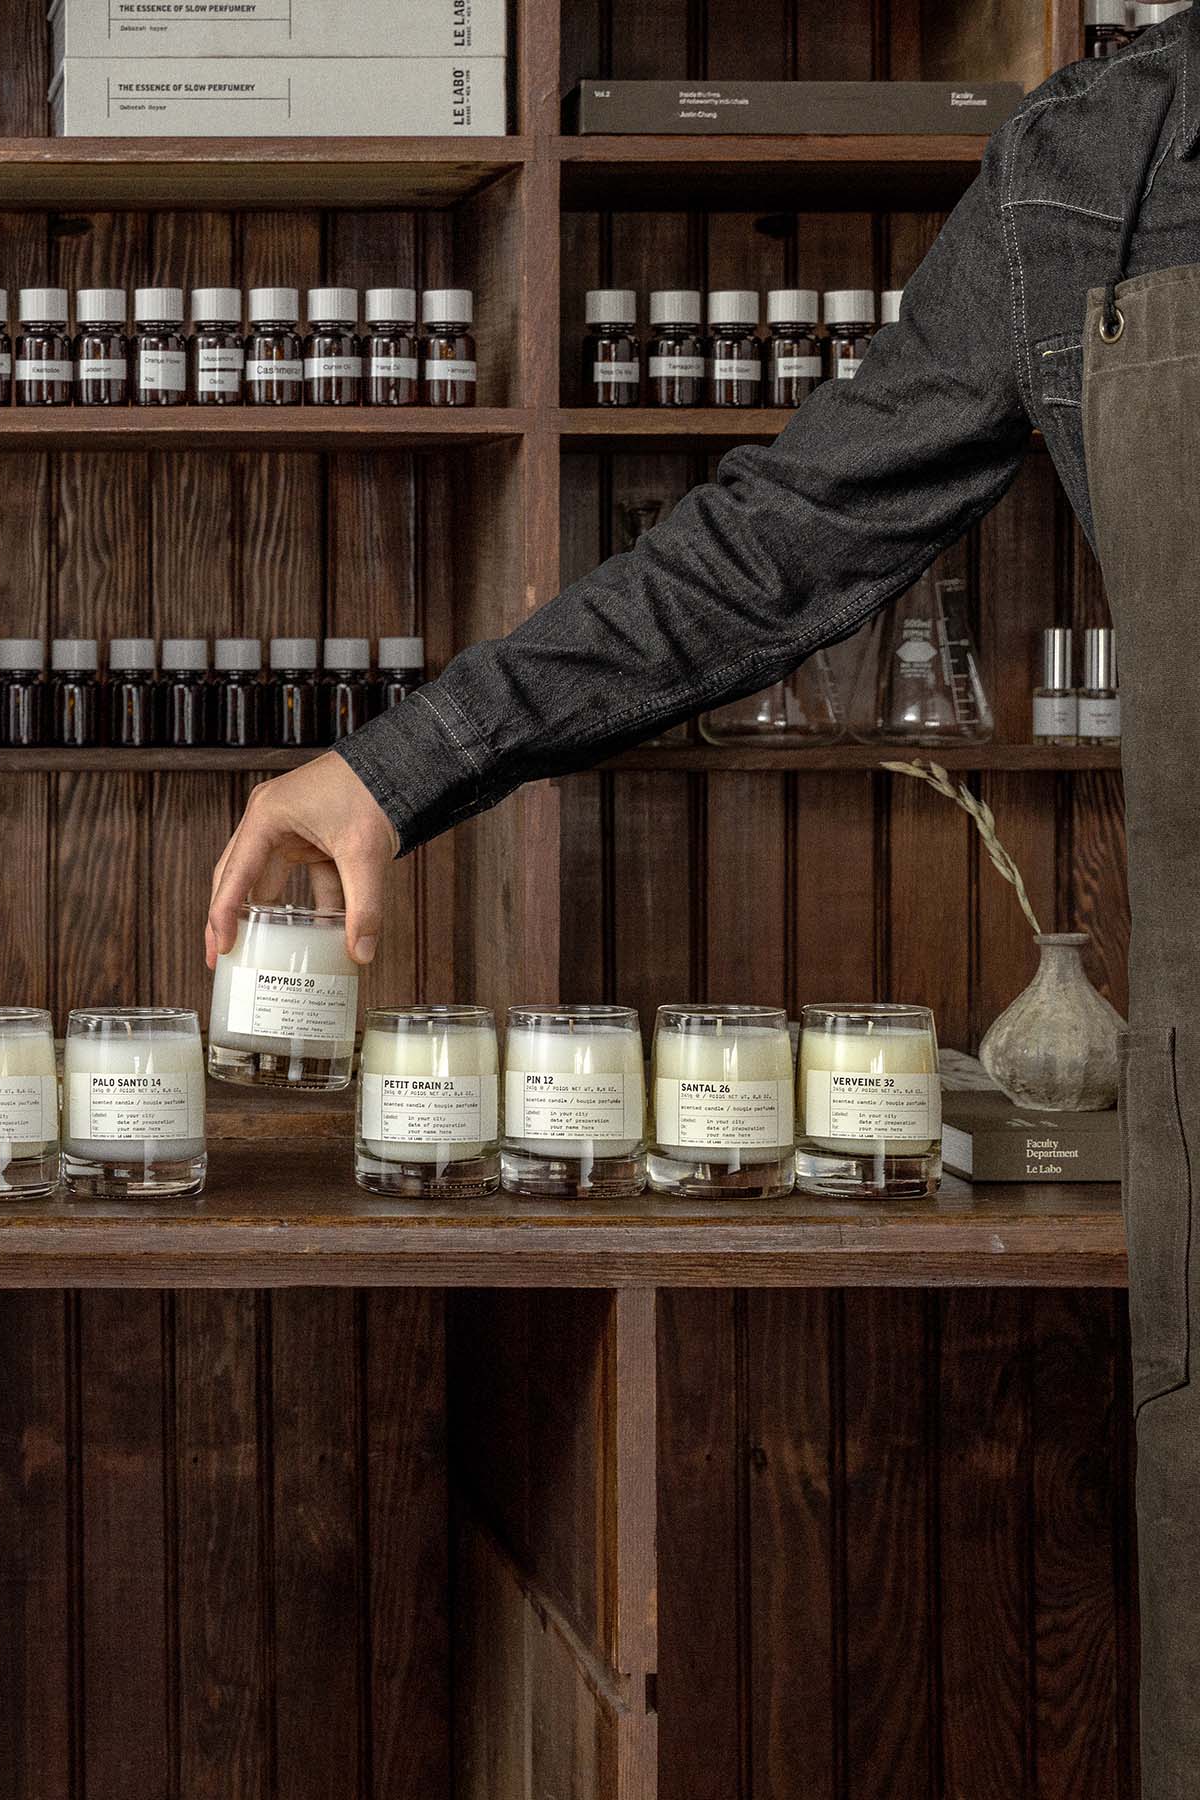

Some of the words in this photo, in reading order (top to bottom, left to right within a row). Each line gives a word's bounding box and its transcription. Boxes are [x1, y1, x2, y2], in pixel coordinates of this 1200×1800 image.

[454, 29, 465, 46] LE
[453, 70, 465, 105] LABO
[453, 108, 465, 125] LE
[699, 111, 717, 119] Chung
[258, 974, 302, 987] PAPYRUS
[304, 979, 315, 988] 20
[93, 1078, 115, 1087] PALO
[117, 1078, 148, 1087] SANTO
[151, 1078, 161, 1086] 14
[384, 1080, 410, 1089] PETIT
[412, 1081, 441, 1090] GRAIN
[443, 1081, 454, 1090] 21
[526, 1076, 541, 1084] PIN
[543, 1076, 554, 1084] 12
[832, 1077, 881, 1086] VERVEINE
[884, 1079, 895, 1087] 32
[681, 1083, 717, 1092] SANTAL
[719, 1084, 730, 1093] 26
[1026, 1138, 1059, 1150] Faculty
[1026, 1149, 1079, 1159] Department
[1026, 1165, 1038, 1174] Le
[1039, 1164, 1062, 1174] Labo
